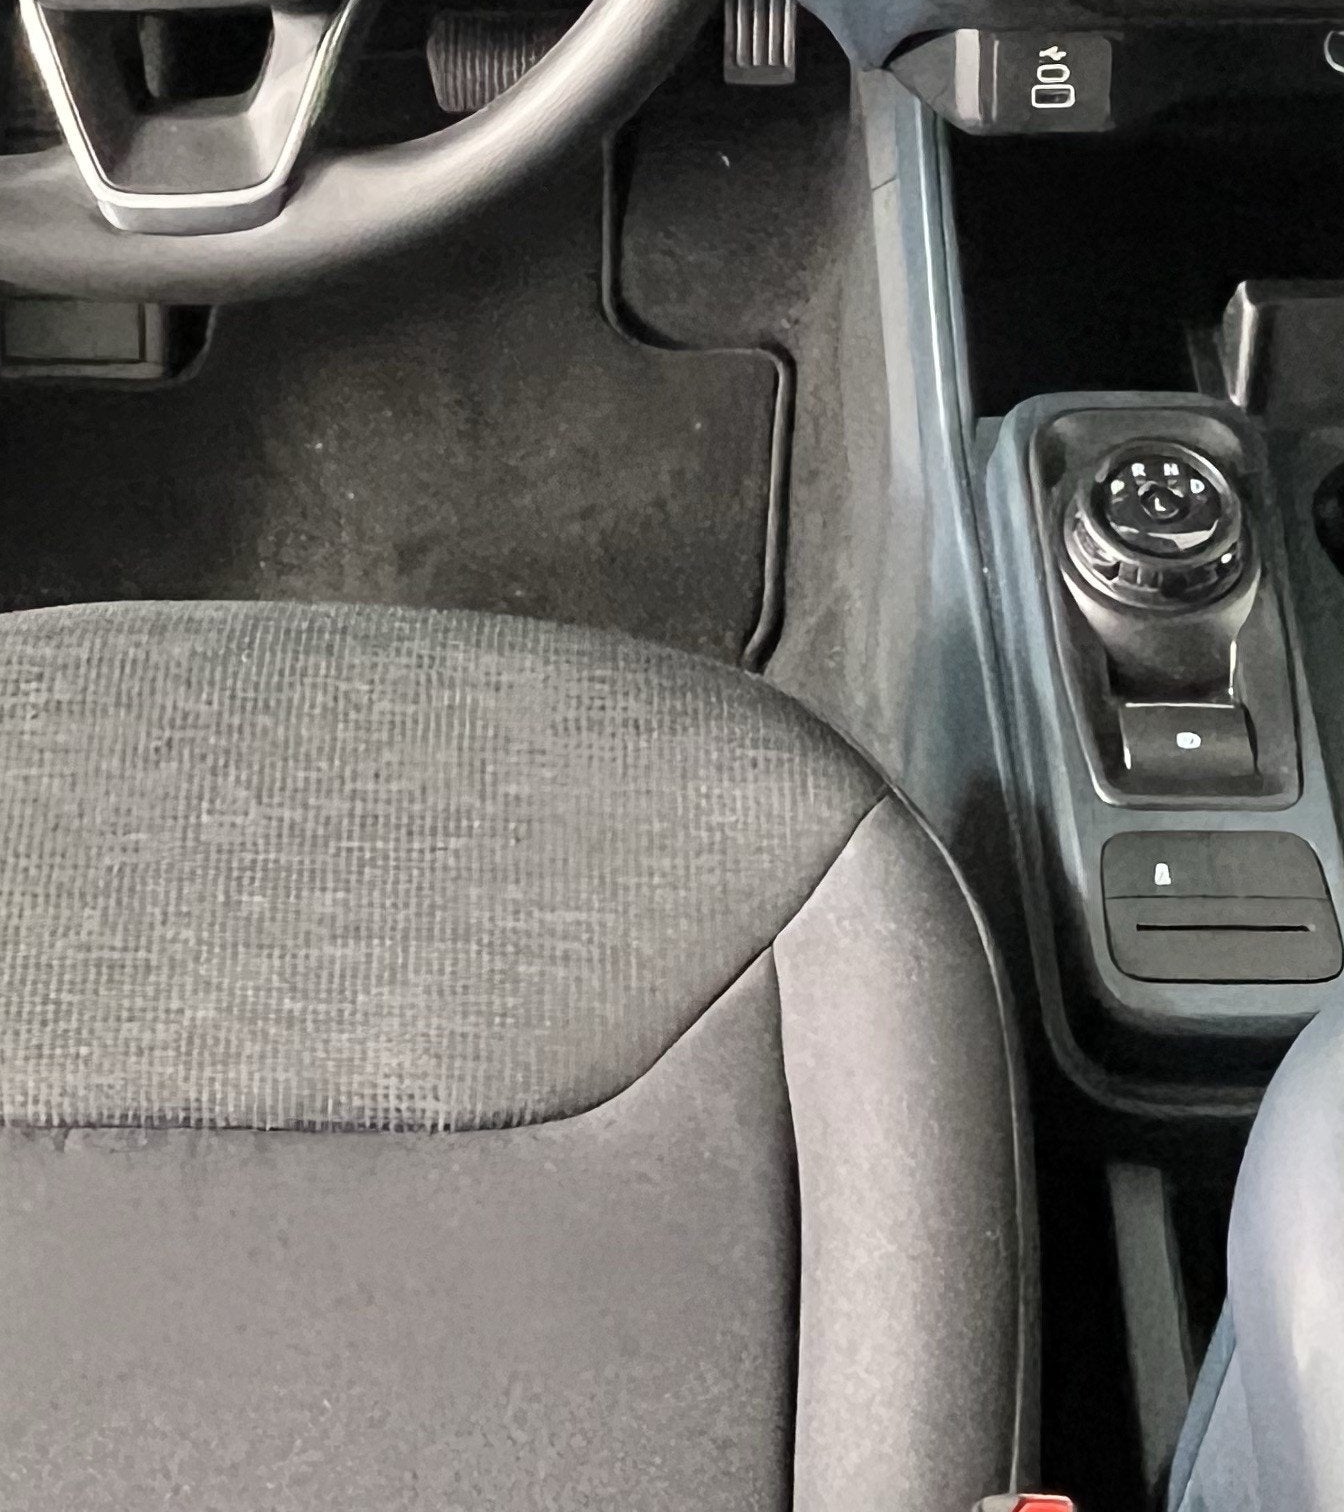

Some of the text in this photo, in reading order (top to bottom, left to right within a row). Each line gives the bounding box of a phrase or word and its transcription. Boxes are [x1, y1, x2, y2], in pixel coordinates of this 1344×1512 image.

[1110, 463, 1205, 495] P R N D
[1154, 497, 1167, 512] L
